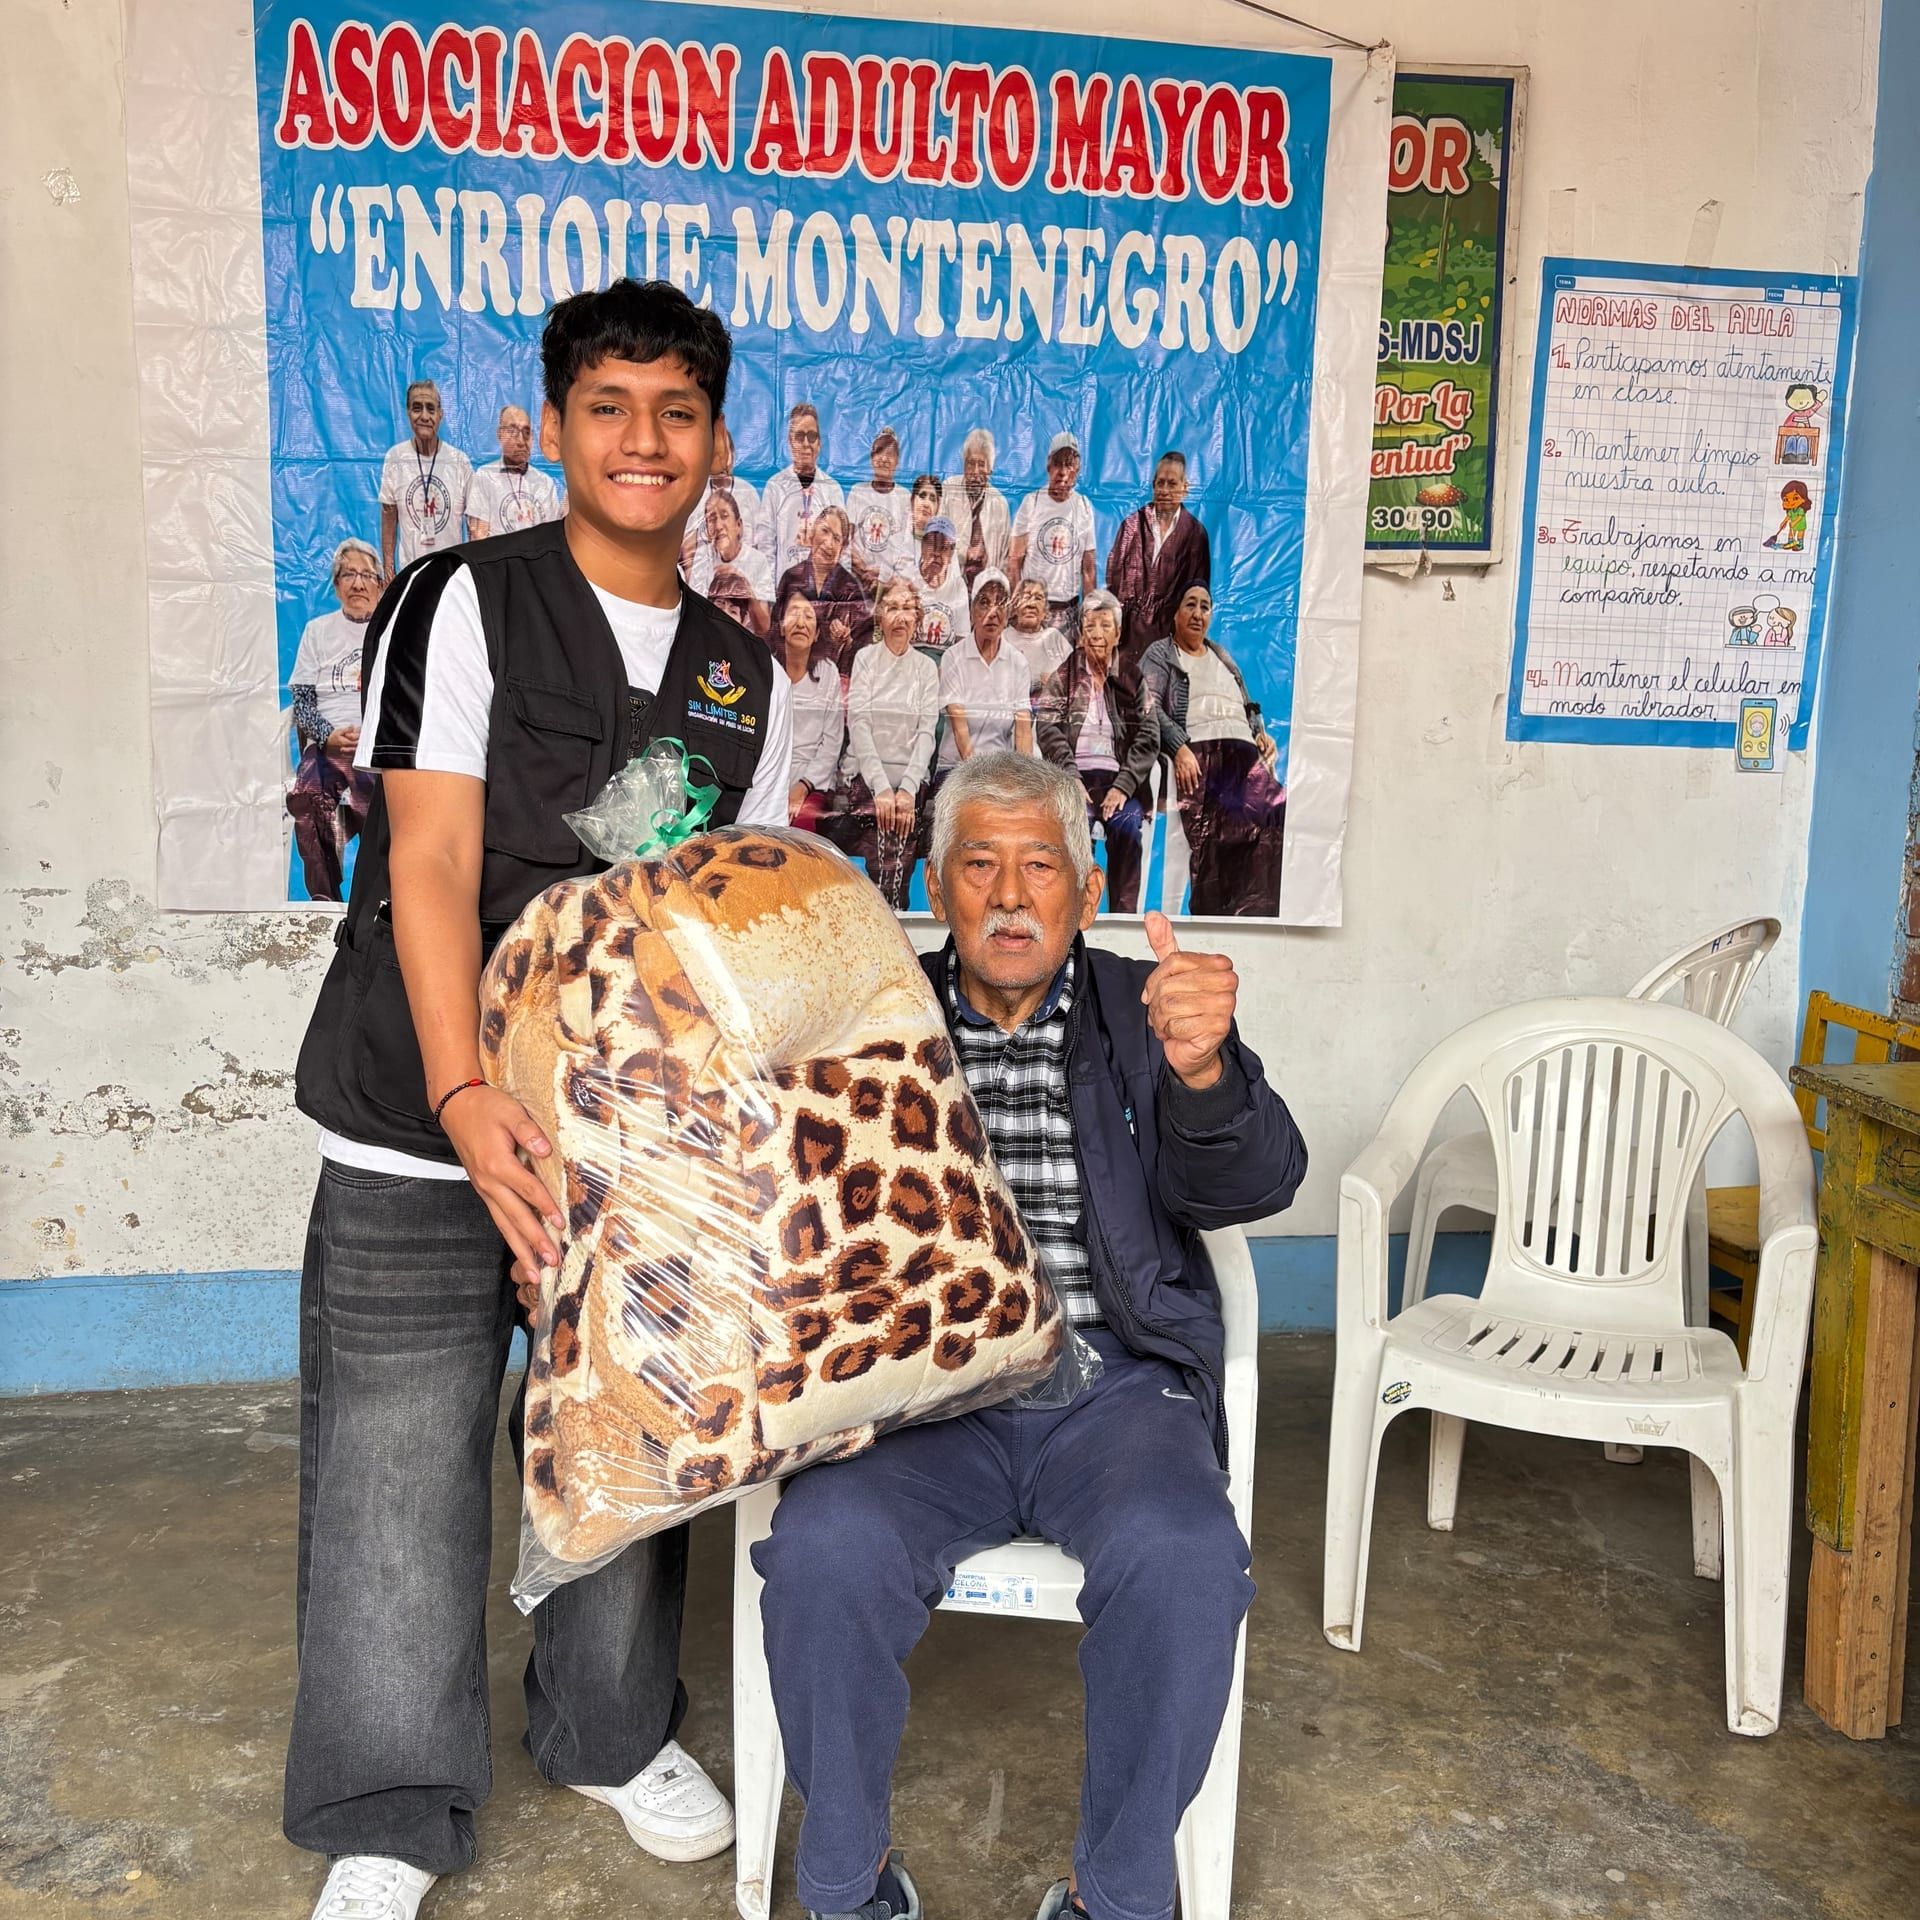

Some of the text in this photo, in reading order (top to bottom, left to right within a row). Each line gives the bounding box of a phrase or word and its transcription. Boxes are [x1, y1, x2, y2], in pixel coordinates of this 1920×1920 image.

[274, 18, 1292, 209] ASOCIACION ADULTO MAYOR
[1388, 119, 1470, 193] OR
[1556, 296, 1794, 338] NORMAS DEL AULA
[1552, 343, 1570, 370] 1.
[1717, 344, 1832, 384] atentamente
[1375, 382, 1473, 431] Por La
[1573, 377, 1677, 405] en clase.
[1543, 428, 1761, 478] 2. Mantener limpio
[1565, 464, 1726, 496] nuestra aula.
[1538, 515, 1743, 560] 3. Trabajamos en
[1563, 552, 1816, 593] equipo, respetando a mi
[1560, 586, 1683, 613] compañero.
[1526, 657, 1801, 694] 4. Mantener el celular en
[741, 713, 756, 727] 360
[1550, 691, 1718, 722] modo vibrador.
